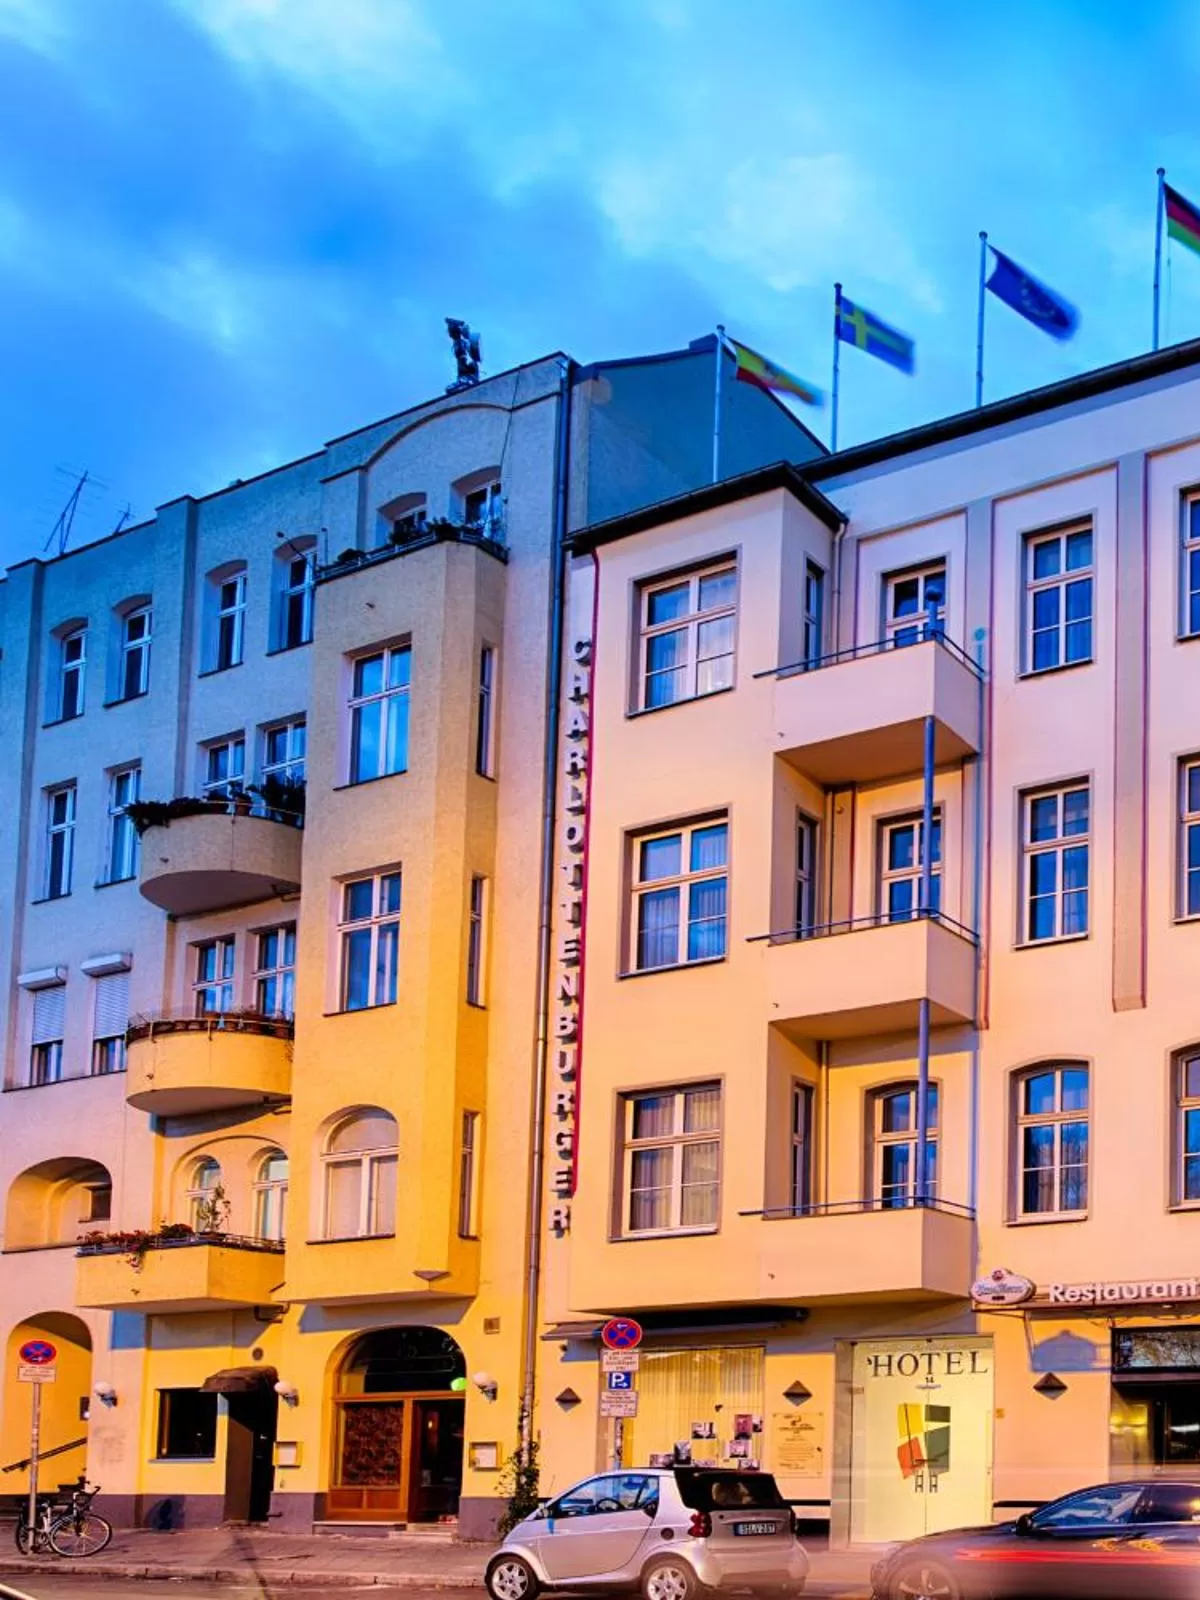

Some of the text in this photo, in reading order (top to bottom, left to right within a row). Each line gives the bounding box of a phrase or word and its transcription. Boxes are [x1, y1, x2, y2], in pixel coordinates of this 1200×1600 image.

[549, 638, 590, 1238] CHARLOTTENBURGER
[1049, 1277, 1200, 1303] Restaurant
[871, 1350, 988, 1377] HOTEL
[612, 1372, 625, 1388] P
